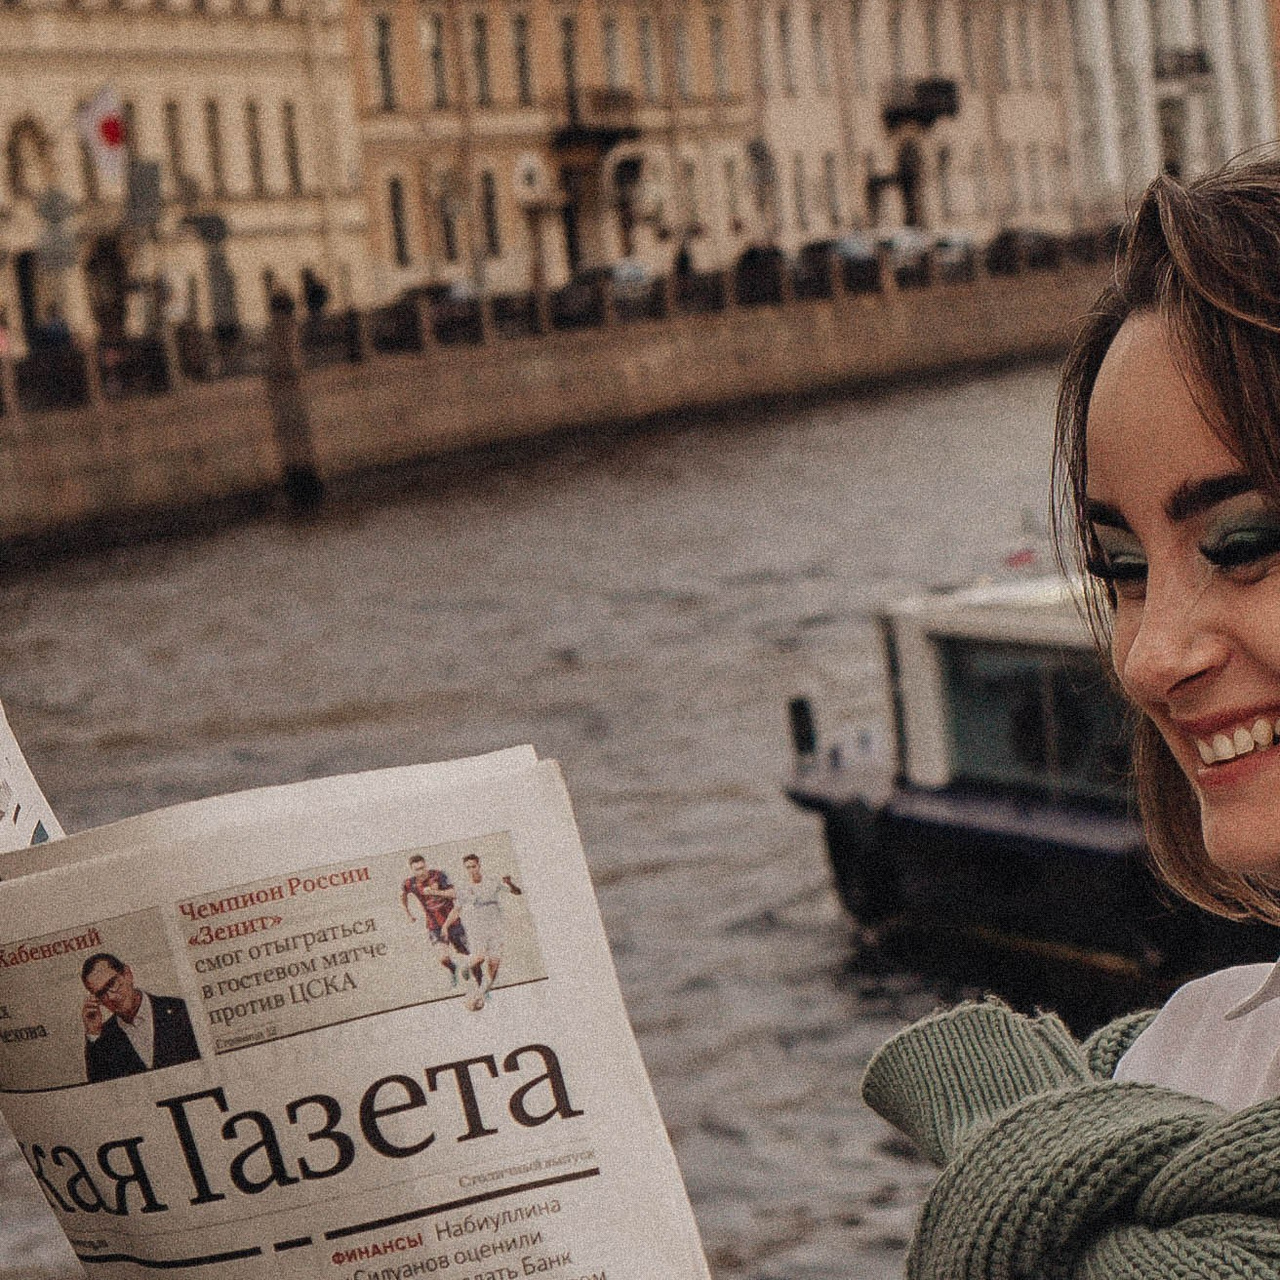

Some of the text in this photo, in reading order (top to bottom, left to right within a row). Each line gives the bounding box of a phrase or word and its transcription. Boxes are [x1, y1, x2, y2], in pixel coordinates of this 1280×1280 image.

[180, 867, 370, 921] Чемпион России
[188, 915, 283, 946] «Зенит»
[195, 918, 378, 974] смог отыграться
[202, 942, 388, 1000] в гостевом матче
[208, 971, 358, 1026] против ЦСКА
[156, 1042, 585, 1208] Газета
[434, 1198, 562, 1241] Набиуллина
[454, 1229, 543, 1265] оценили
[522, 1250, 573, 1277] Банк
